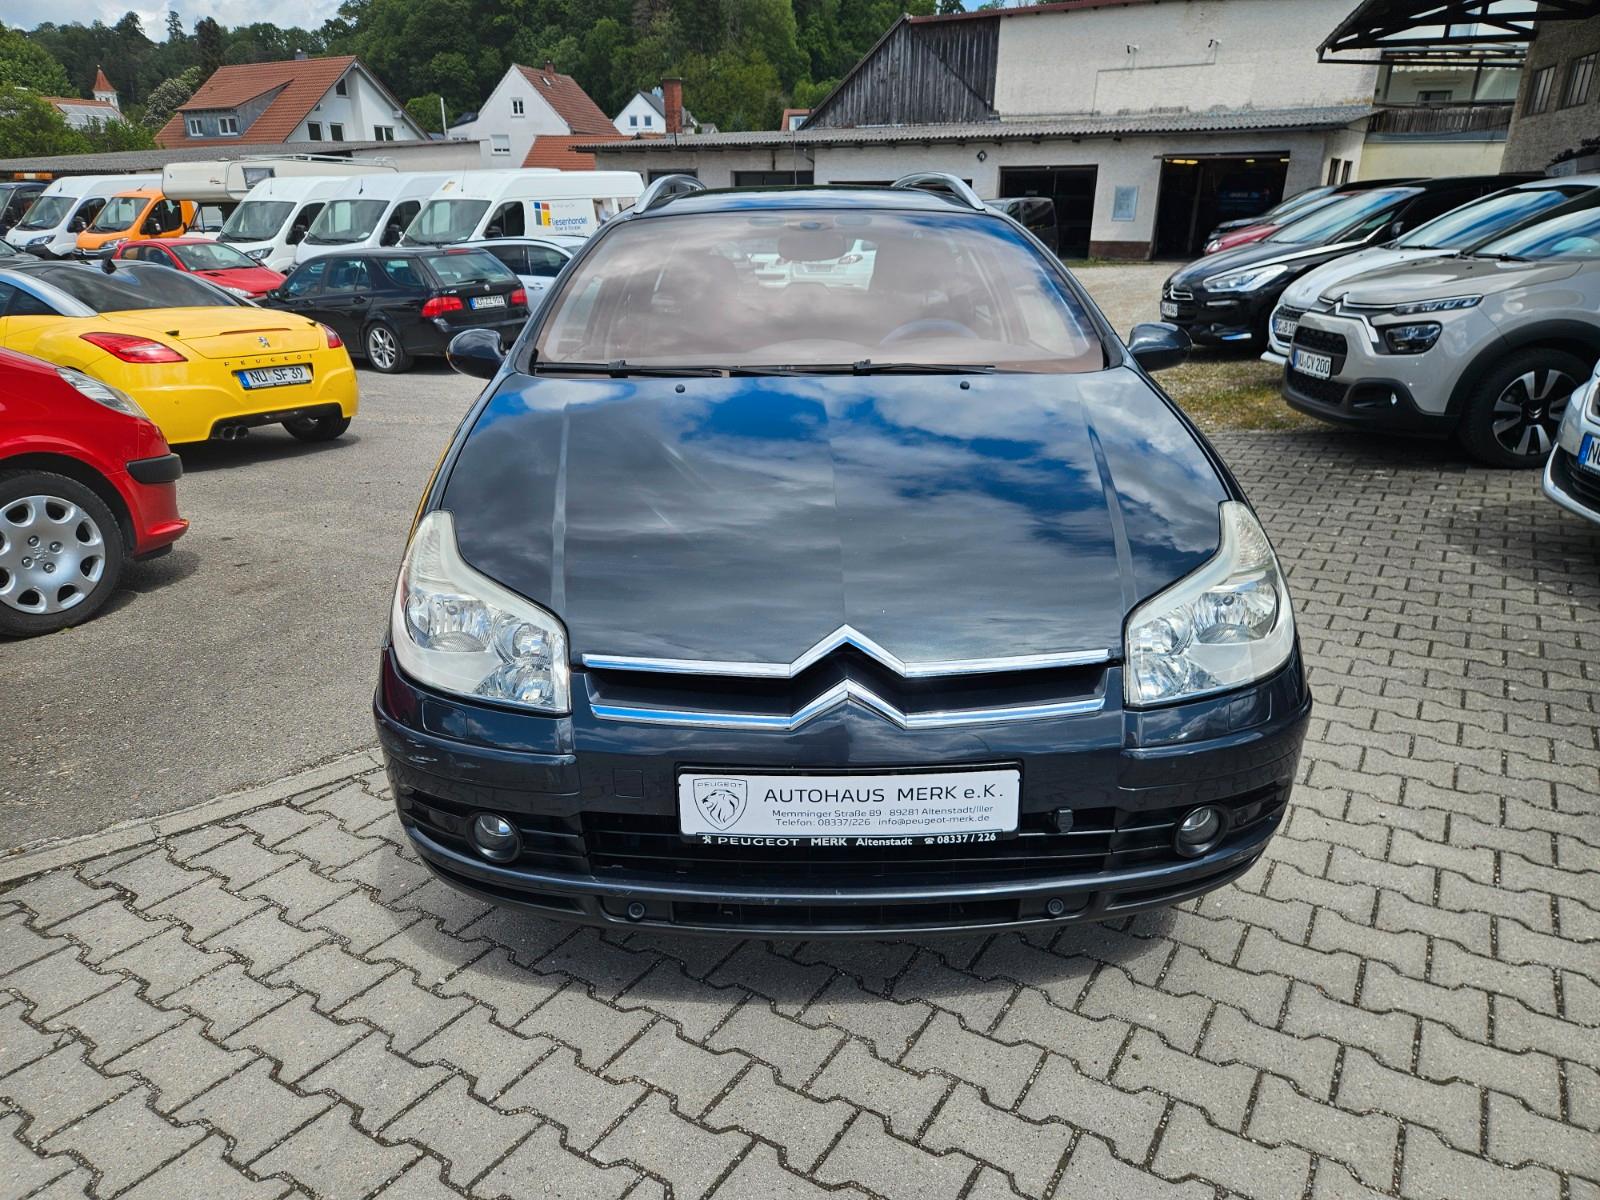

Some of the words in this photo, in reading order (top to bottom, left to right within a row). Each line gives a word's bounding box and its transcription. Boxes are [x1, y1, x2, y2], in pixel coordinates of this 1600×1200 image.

[548, 216, 588, 226] Fliesenhandel
[224, 354, 312, 366] PEUGEOT
[1306, 355, 1316, 370] CY
[1316, 358, 1330, 374] 200
[249, 370, 268, 383] NU
[272, 368, 287, 381] SF
[289, 367, 303, 379] 39
[764, 788, 885, 803] AUTOHAUS
[897, 786, 959, 802] MERK
[964, 783, 1004, 799] e.K.
[772, 809, 832, 819] Memminger
[834, 809, 867, 818] Straße
[869, 809, 882, 817] 89
[889, 808, 919, 817] 89281
[921, 806, 994, 816] Altenstadt/Iller
[776, 818, 813, 827] Telefon:
[818, 818, 871, 827] 08337/226
[878, 815, 990, 826] info@peugeot-merk.de
[718, 837, 800, 847] PEUGEOT
[810, 837, 848, 847] MERK
[855, 836, 913, 847] Altenstadt
[936, 833, 968, 845] 08337
[977, 832, 997, 842] 226
